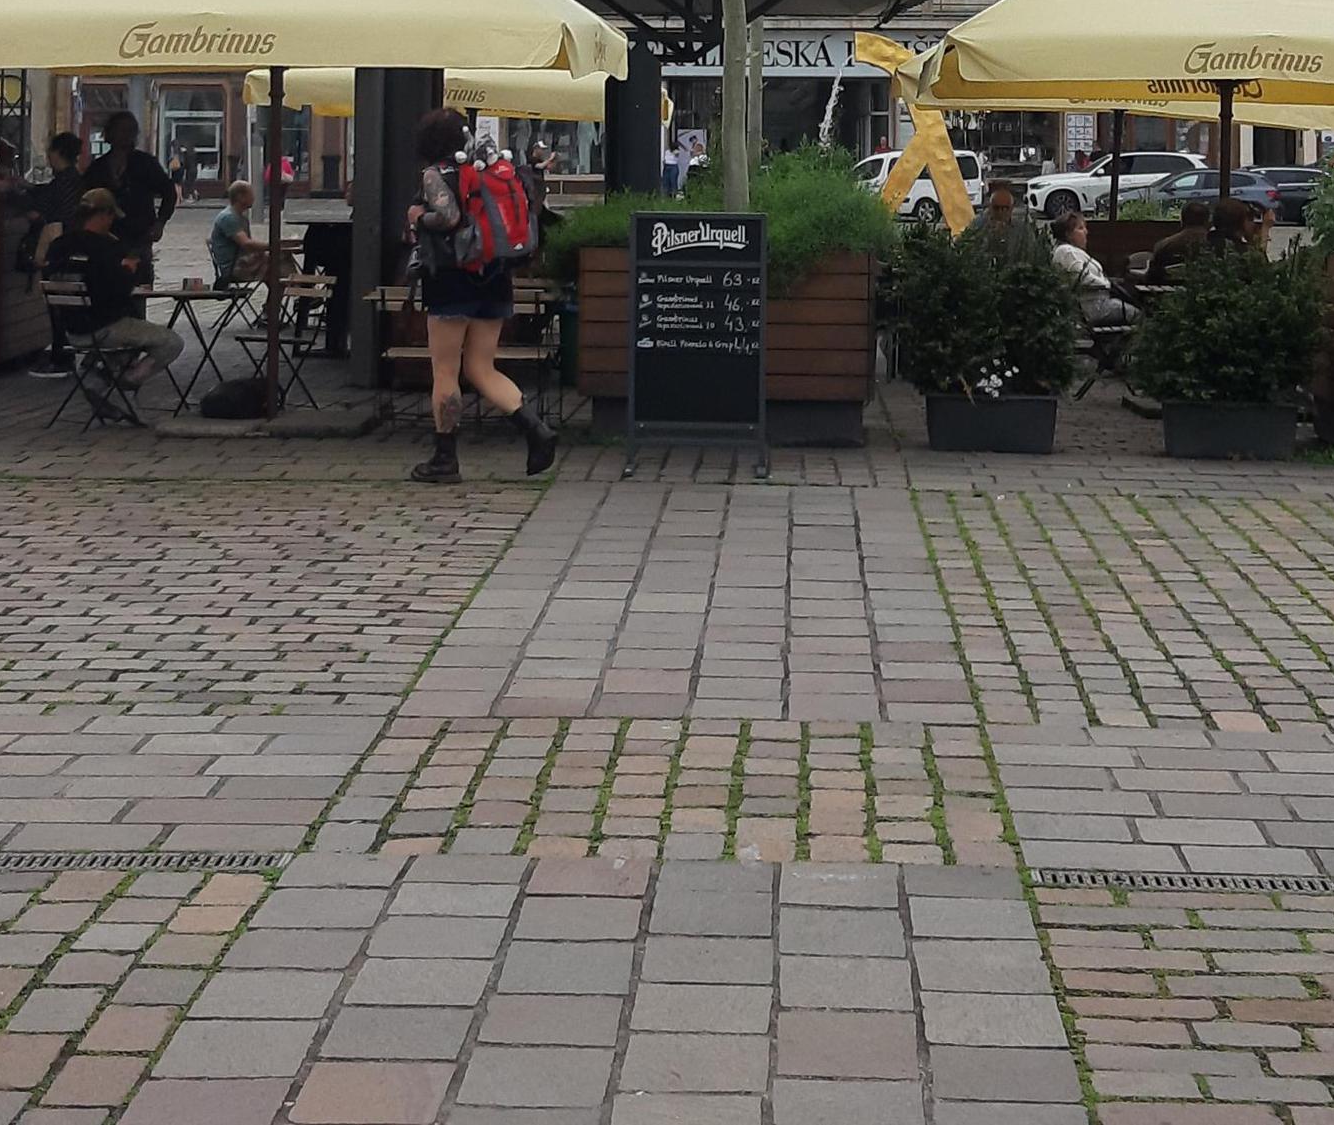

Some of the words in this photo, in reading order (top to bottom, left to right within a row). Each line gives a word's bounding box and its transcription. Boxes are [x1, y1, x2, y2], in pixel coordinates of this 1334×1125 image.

[119, 21, 276, 59] Gambrinus
[761, 35, 835, 68] ESKÁ
[1184, 42, 1323, 74] Gambrinus
[651, 222, 701, 256] Pilsner
[698, 221, 746, 250] Urquell
[657, 274, 684, 283] Pilsner
[686, 275, 712, 287] Urquell
[723, 271, 742, 287] 63
